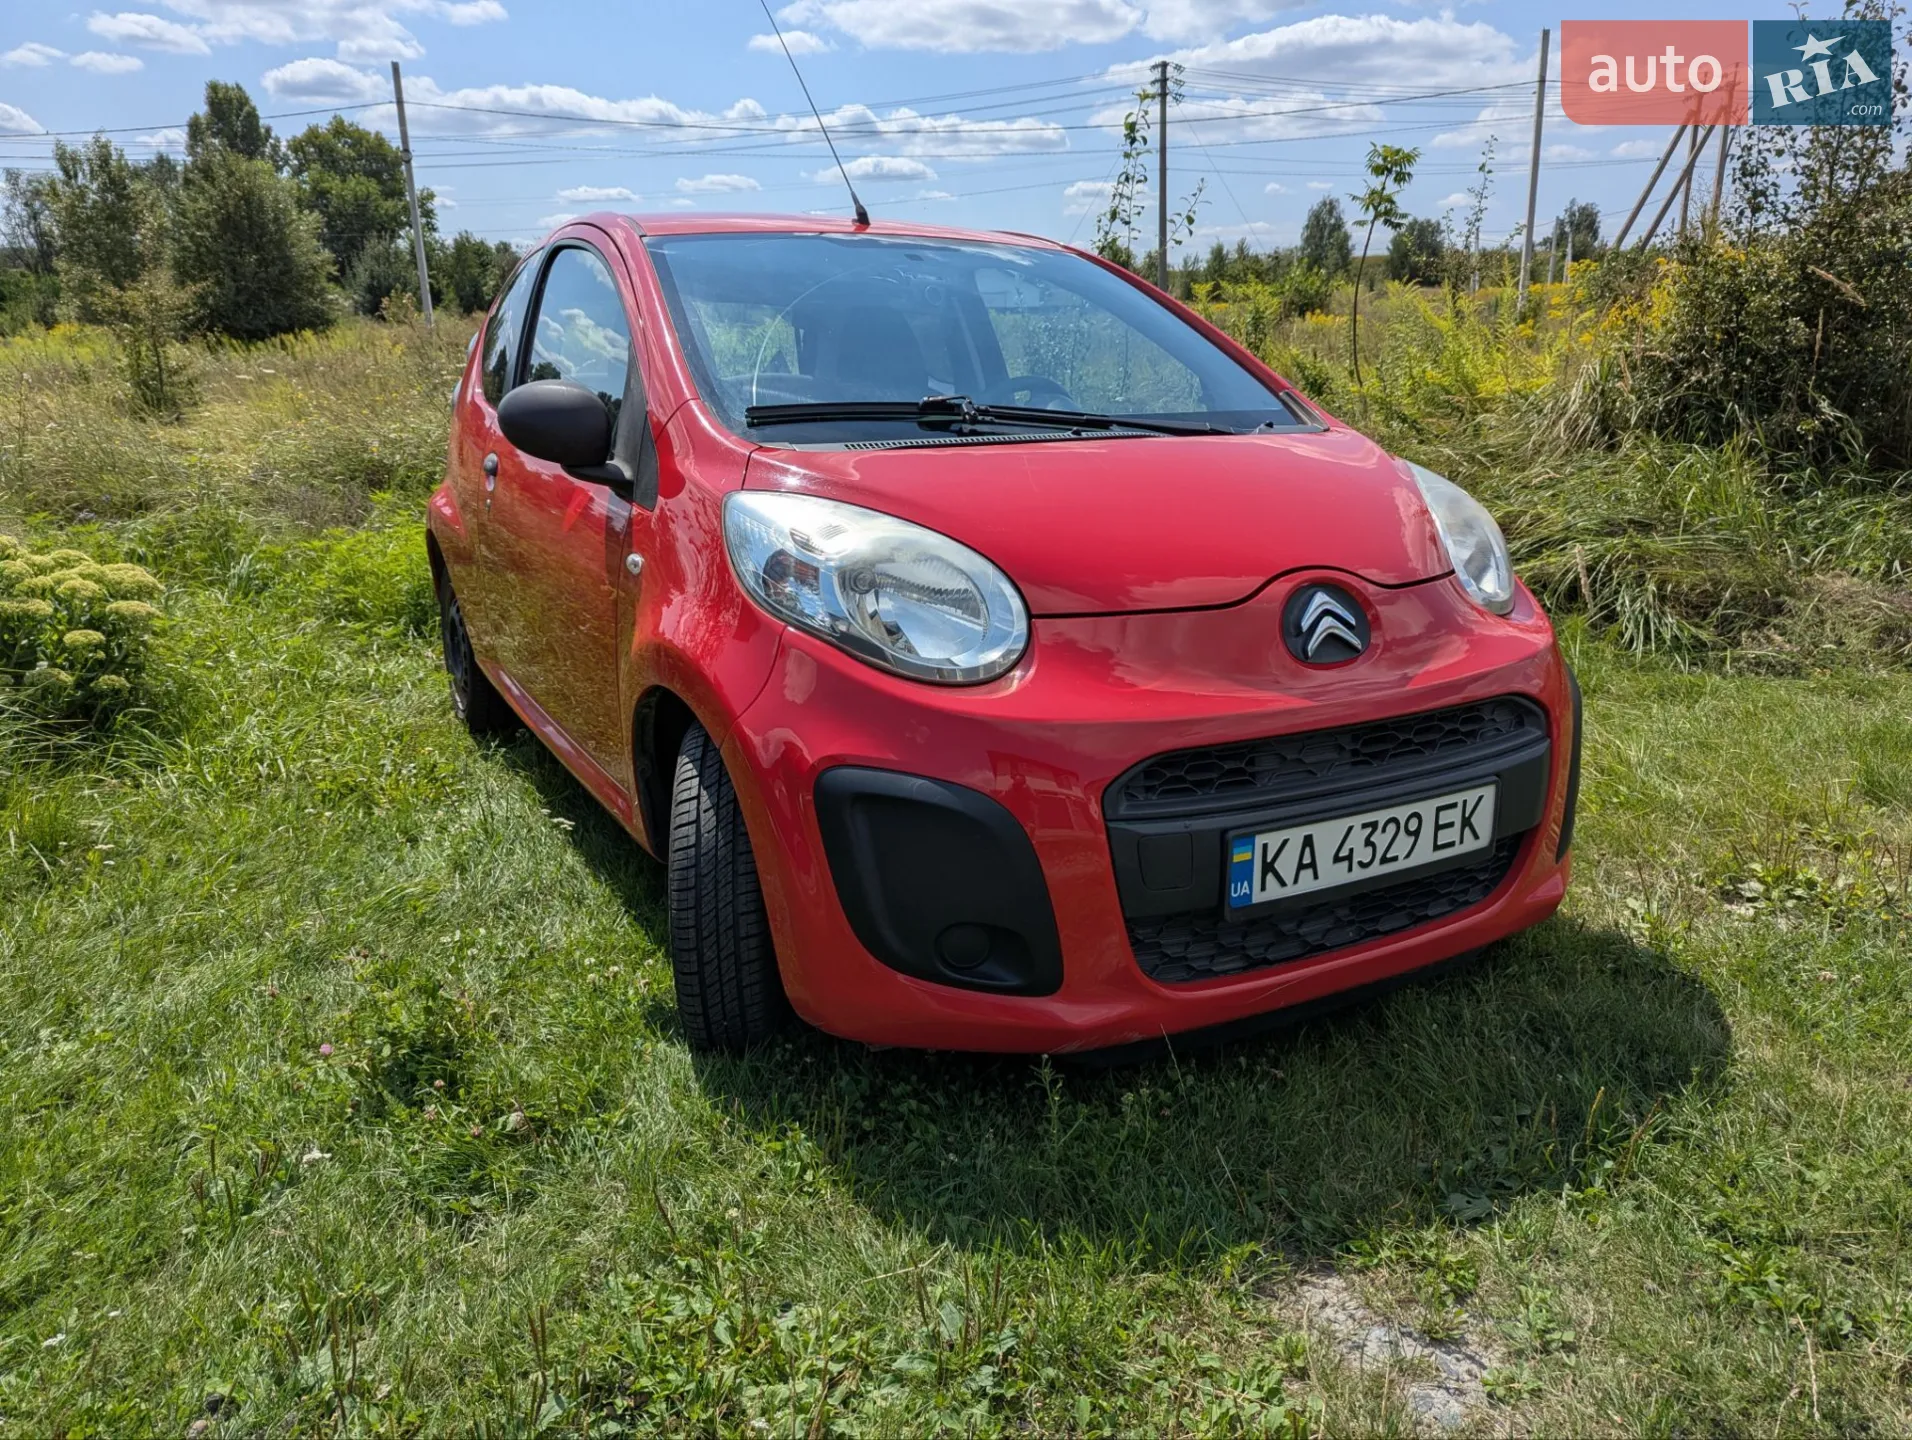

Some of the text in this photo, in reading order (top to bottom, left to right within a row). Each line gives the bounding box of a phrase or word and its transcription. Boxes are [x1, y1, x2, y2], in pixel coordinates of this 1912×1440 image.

[1260, 794, 1485, 892] KA 4329 EK
[1231, 881, 1250, 898] UA
